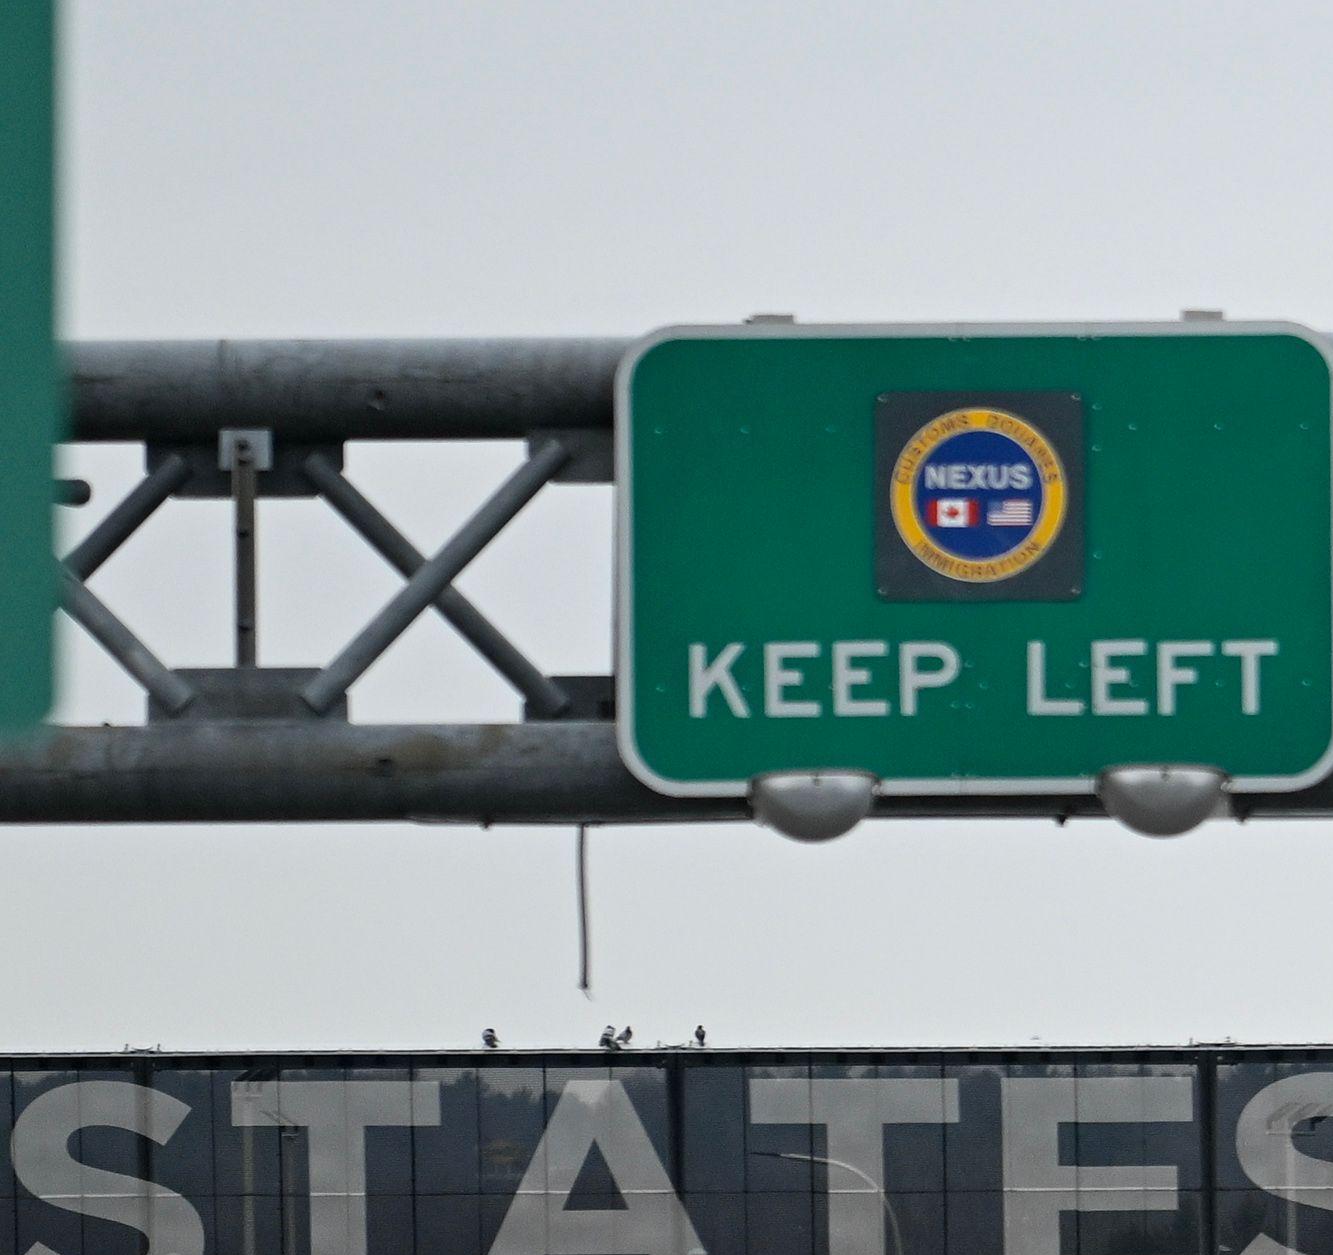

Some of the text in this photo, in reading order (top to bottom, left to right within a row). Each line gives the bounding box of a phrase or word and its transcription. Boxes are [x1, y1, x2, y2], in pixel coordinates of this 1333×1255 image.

[924, 463, 1033, 490] NEXUS
[688, 639, 1278, 718] KEEP LEFT
